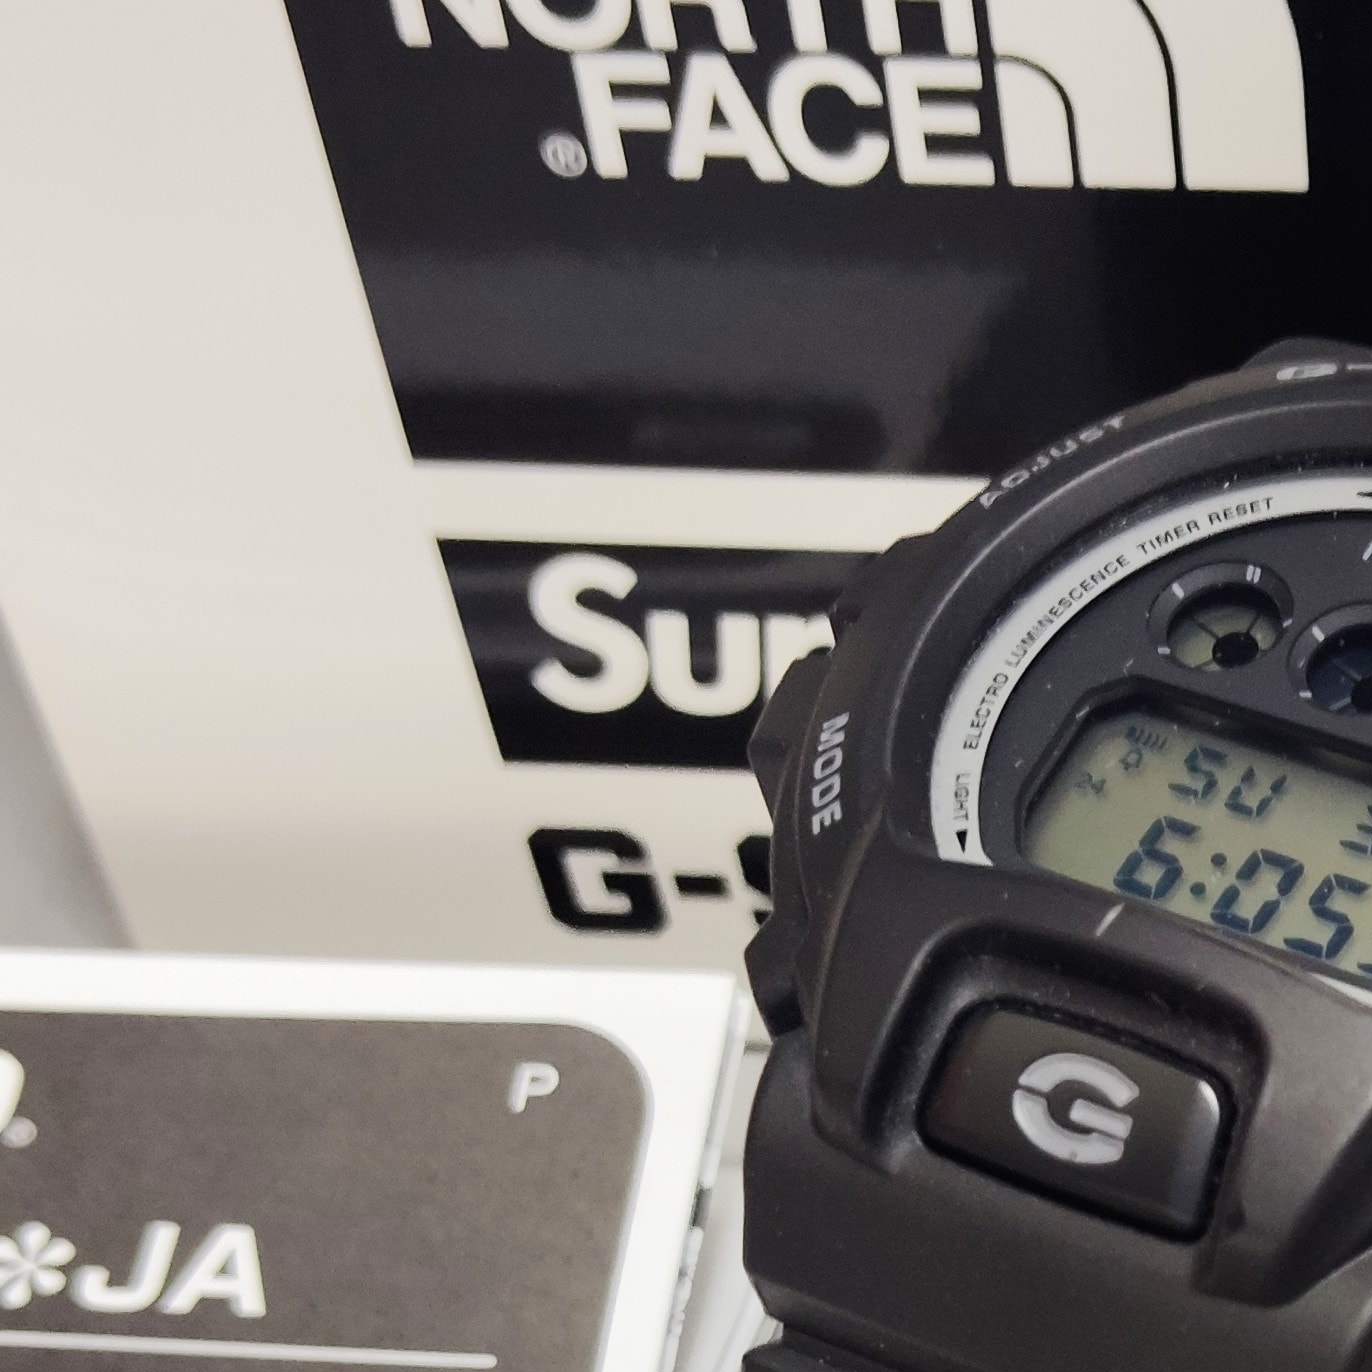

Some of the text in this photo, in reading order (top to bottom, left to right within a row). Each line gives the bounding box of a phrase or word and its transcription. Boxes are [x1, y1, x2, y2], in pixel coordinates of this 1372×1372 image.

[571, 50, 997, 187] FACE
[962, 671, 1010, 752] ELECTRO
[1004, 553, 1131, 668] LUMINESCENCE
[1136, 519, 1200, 556] TIMER
[1207, 496, 1274, 527] RESET
[811, 710, 850, 836] MODE
[1113, 815, 1372, 959] 6:05
[508, 1061, 560, 1114] P
[1012, 1052, 1141, 1165] G
